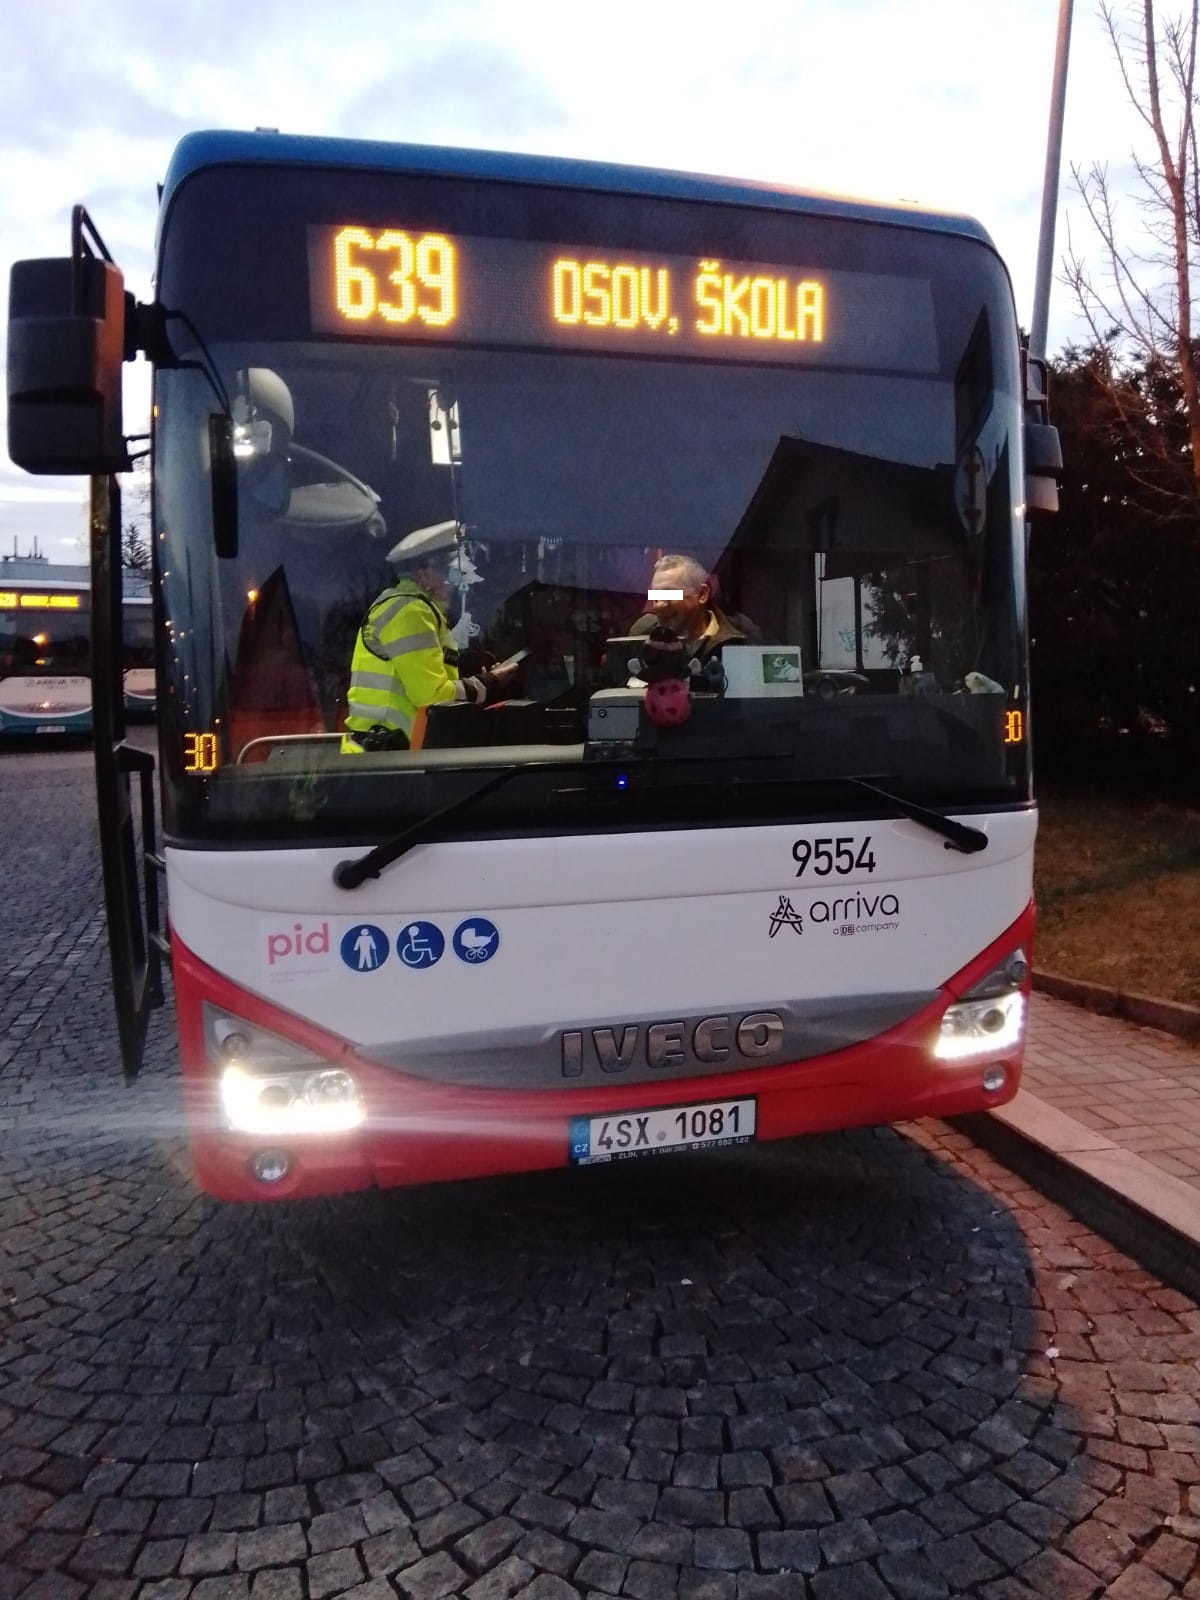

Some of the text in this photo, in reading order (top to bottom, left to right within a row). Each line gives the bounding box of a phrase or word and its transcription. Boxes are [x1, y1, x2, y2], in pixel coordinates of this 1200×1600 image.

[334, 225, 825, 342] 639 OSOV, ŠKOLA
[1004, 710, 1022, 742] 30
[184, 733, 216, 770] 30
[791, 836, 877, 878] 9554
[809, 891, 900, 923] arriva
[267, 922, 331, 965] pid
[840, 924, 855, 936] DB
[855, 921, 900, 934] company
[562, 1011, 785, 1077] IVECO
[597, 1105, 740, 1150] 4SX 1081
[574, 1143, 589, 1153] CZ
